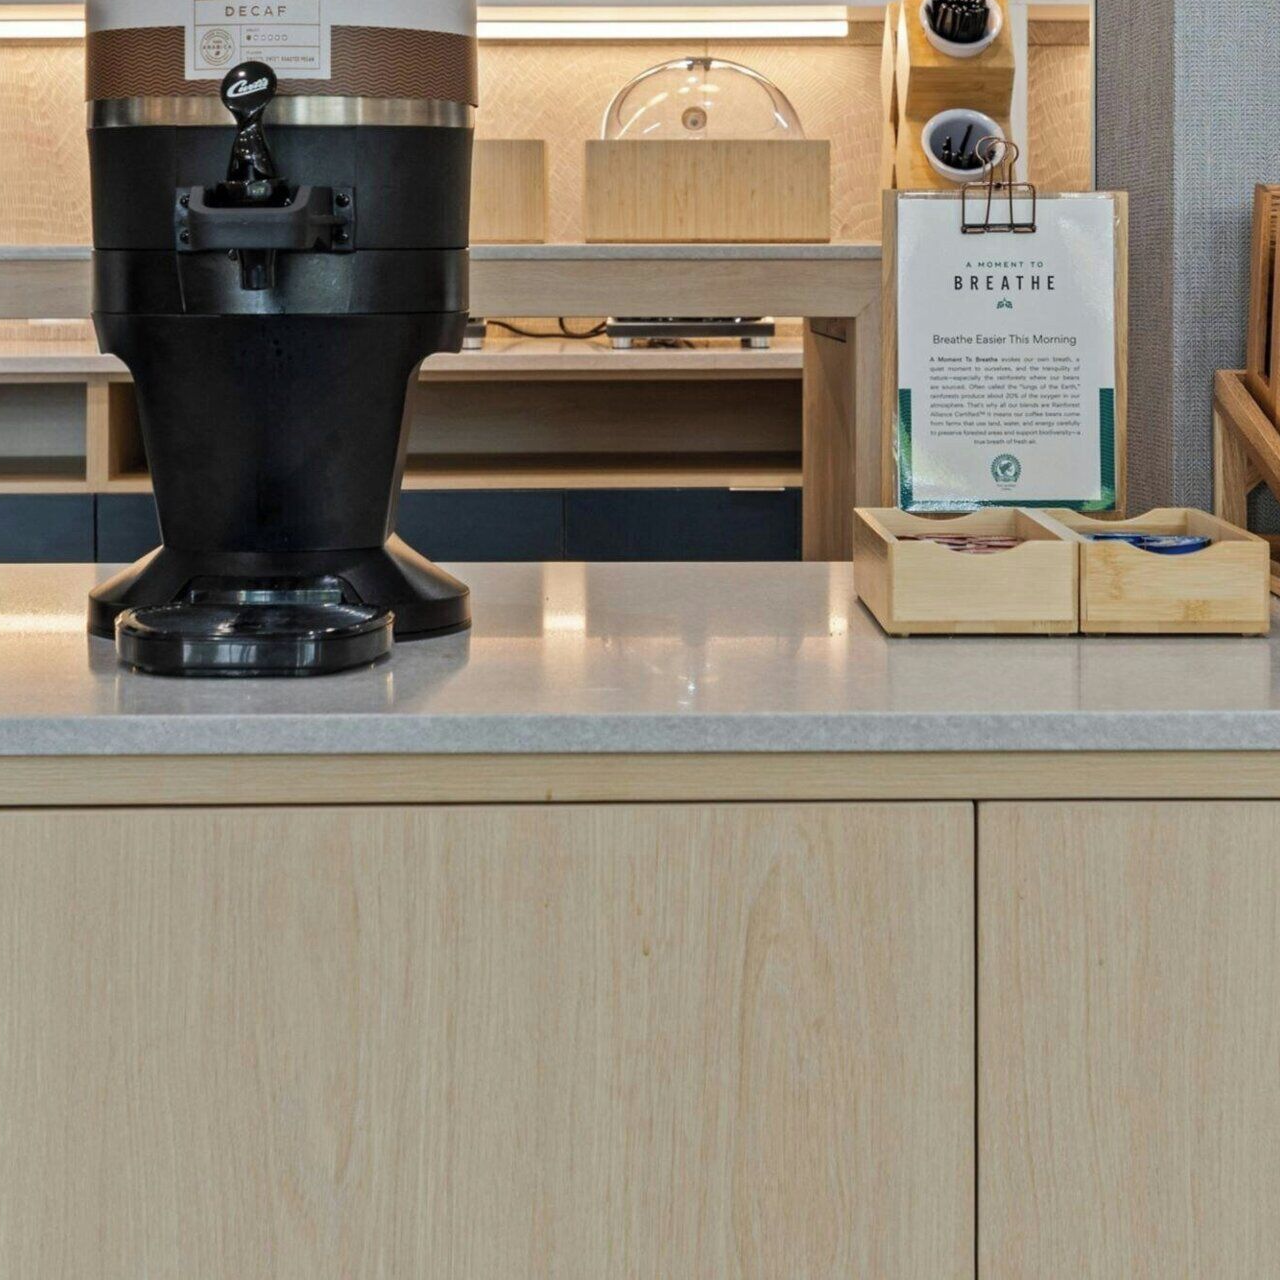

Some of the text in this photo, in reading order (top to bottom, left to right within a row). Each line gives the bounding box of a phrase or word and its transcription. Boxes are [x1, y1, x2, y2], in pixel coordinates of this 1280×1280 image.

[225, 6, 287, 17] DECAF
[953, 276, 1056, 291] BREATHE
[932, 334, 1076, 346] Breathe Easier This Morning
